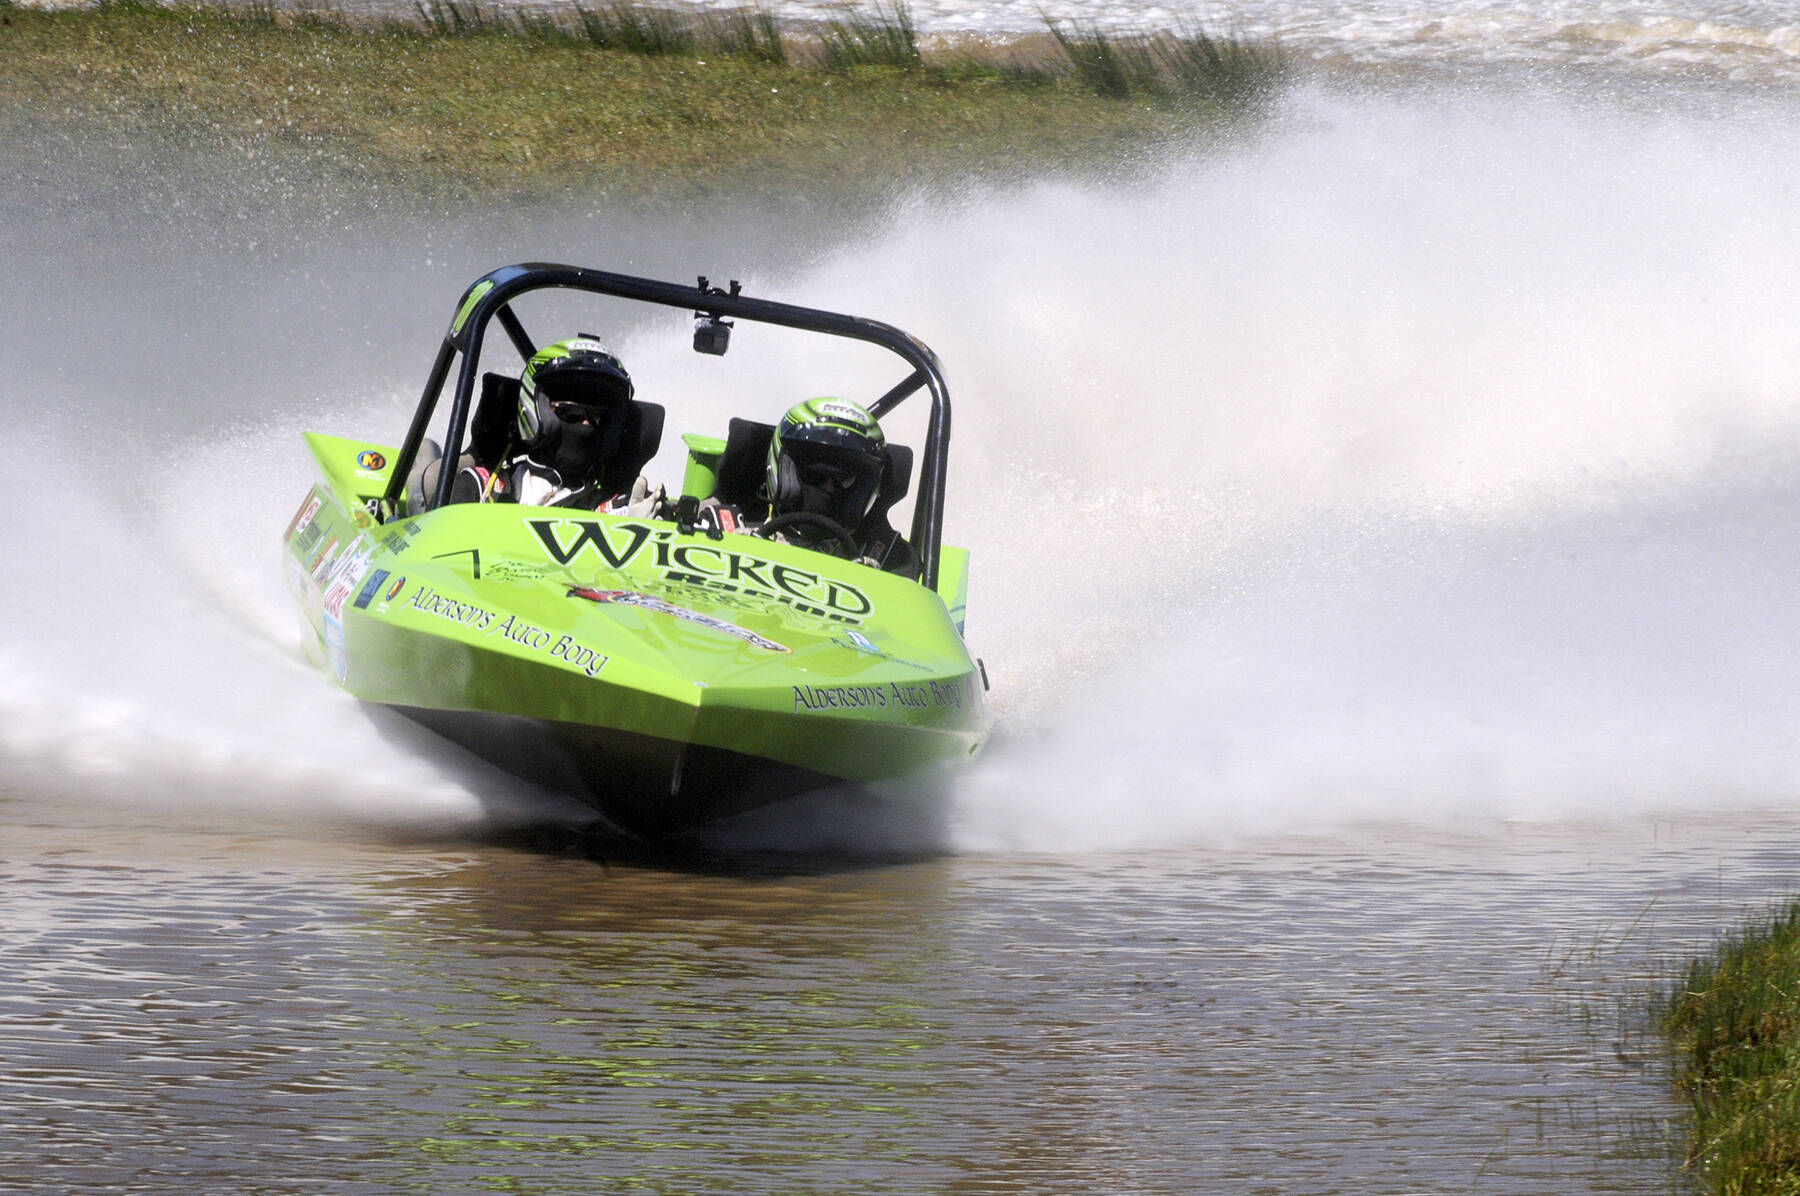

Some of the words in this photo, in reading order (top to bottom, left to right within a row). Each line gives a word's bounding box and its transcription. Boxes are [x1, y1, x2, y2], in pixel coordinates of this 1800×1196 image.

[525, 518, 873, 617] WICKED
[489, 615, 551, 649] AUTO
[549, 634, 609, 677] BODY
[890, 682, 928, 711] AUTO
